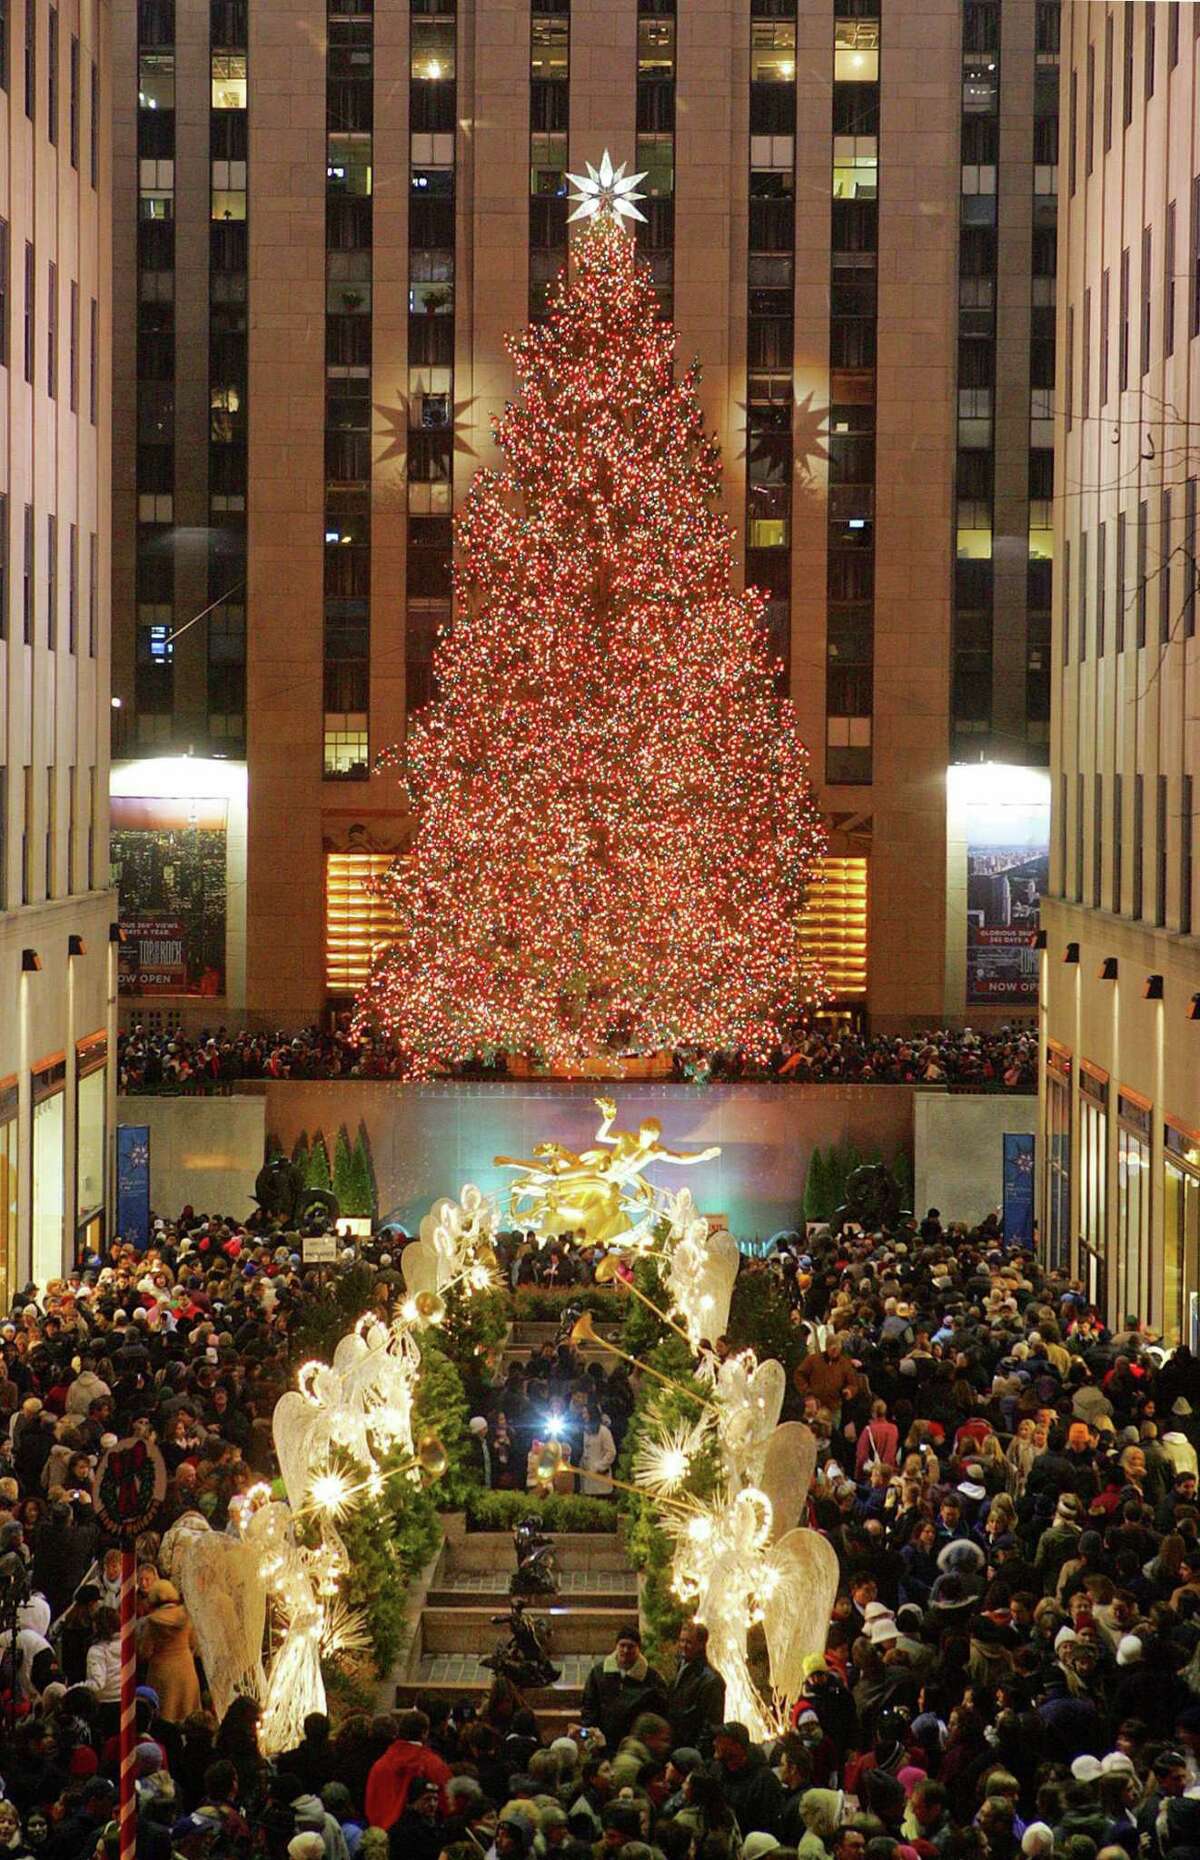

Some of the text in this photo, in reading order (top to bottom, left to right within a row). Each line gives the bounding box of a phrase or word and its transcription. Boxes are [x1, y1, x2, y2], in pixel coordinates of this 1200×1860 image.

[160, 940, 182, 964] ROCK
[118, 974, 172, 984] OW OPEN
[989, 982, 1018, 992] NOW
